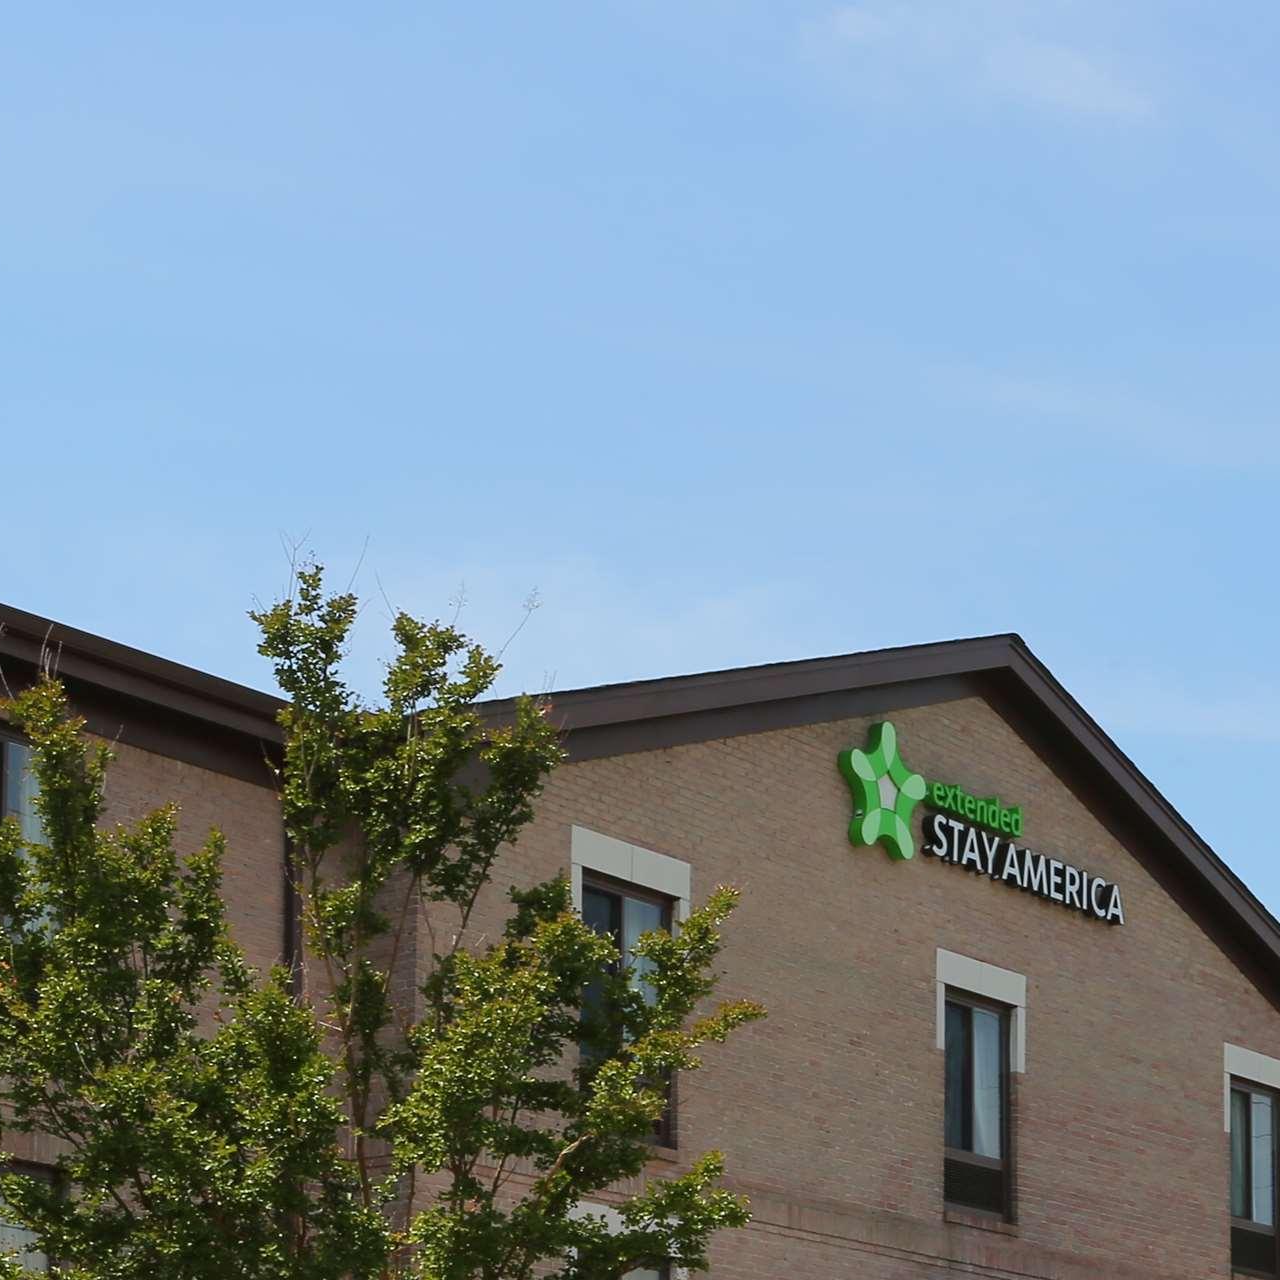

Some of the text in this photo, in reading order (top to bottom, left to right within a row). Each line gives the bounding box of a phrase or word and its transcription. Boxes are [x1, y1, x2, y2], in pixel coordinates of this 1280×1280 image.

[932, 782, 1022, 836] extended
[931, 814, 1125, 925] STAY AMERICA
